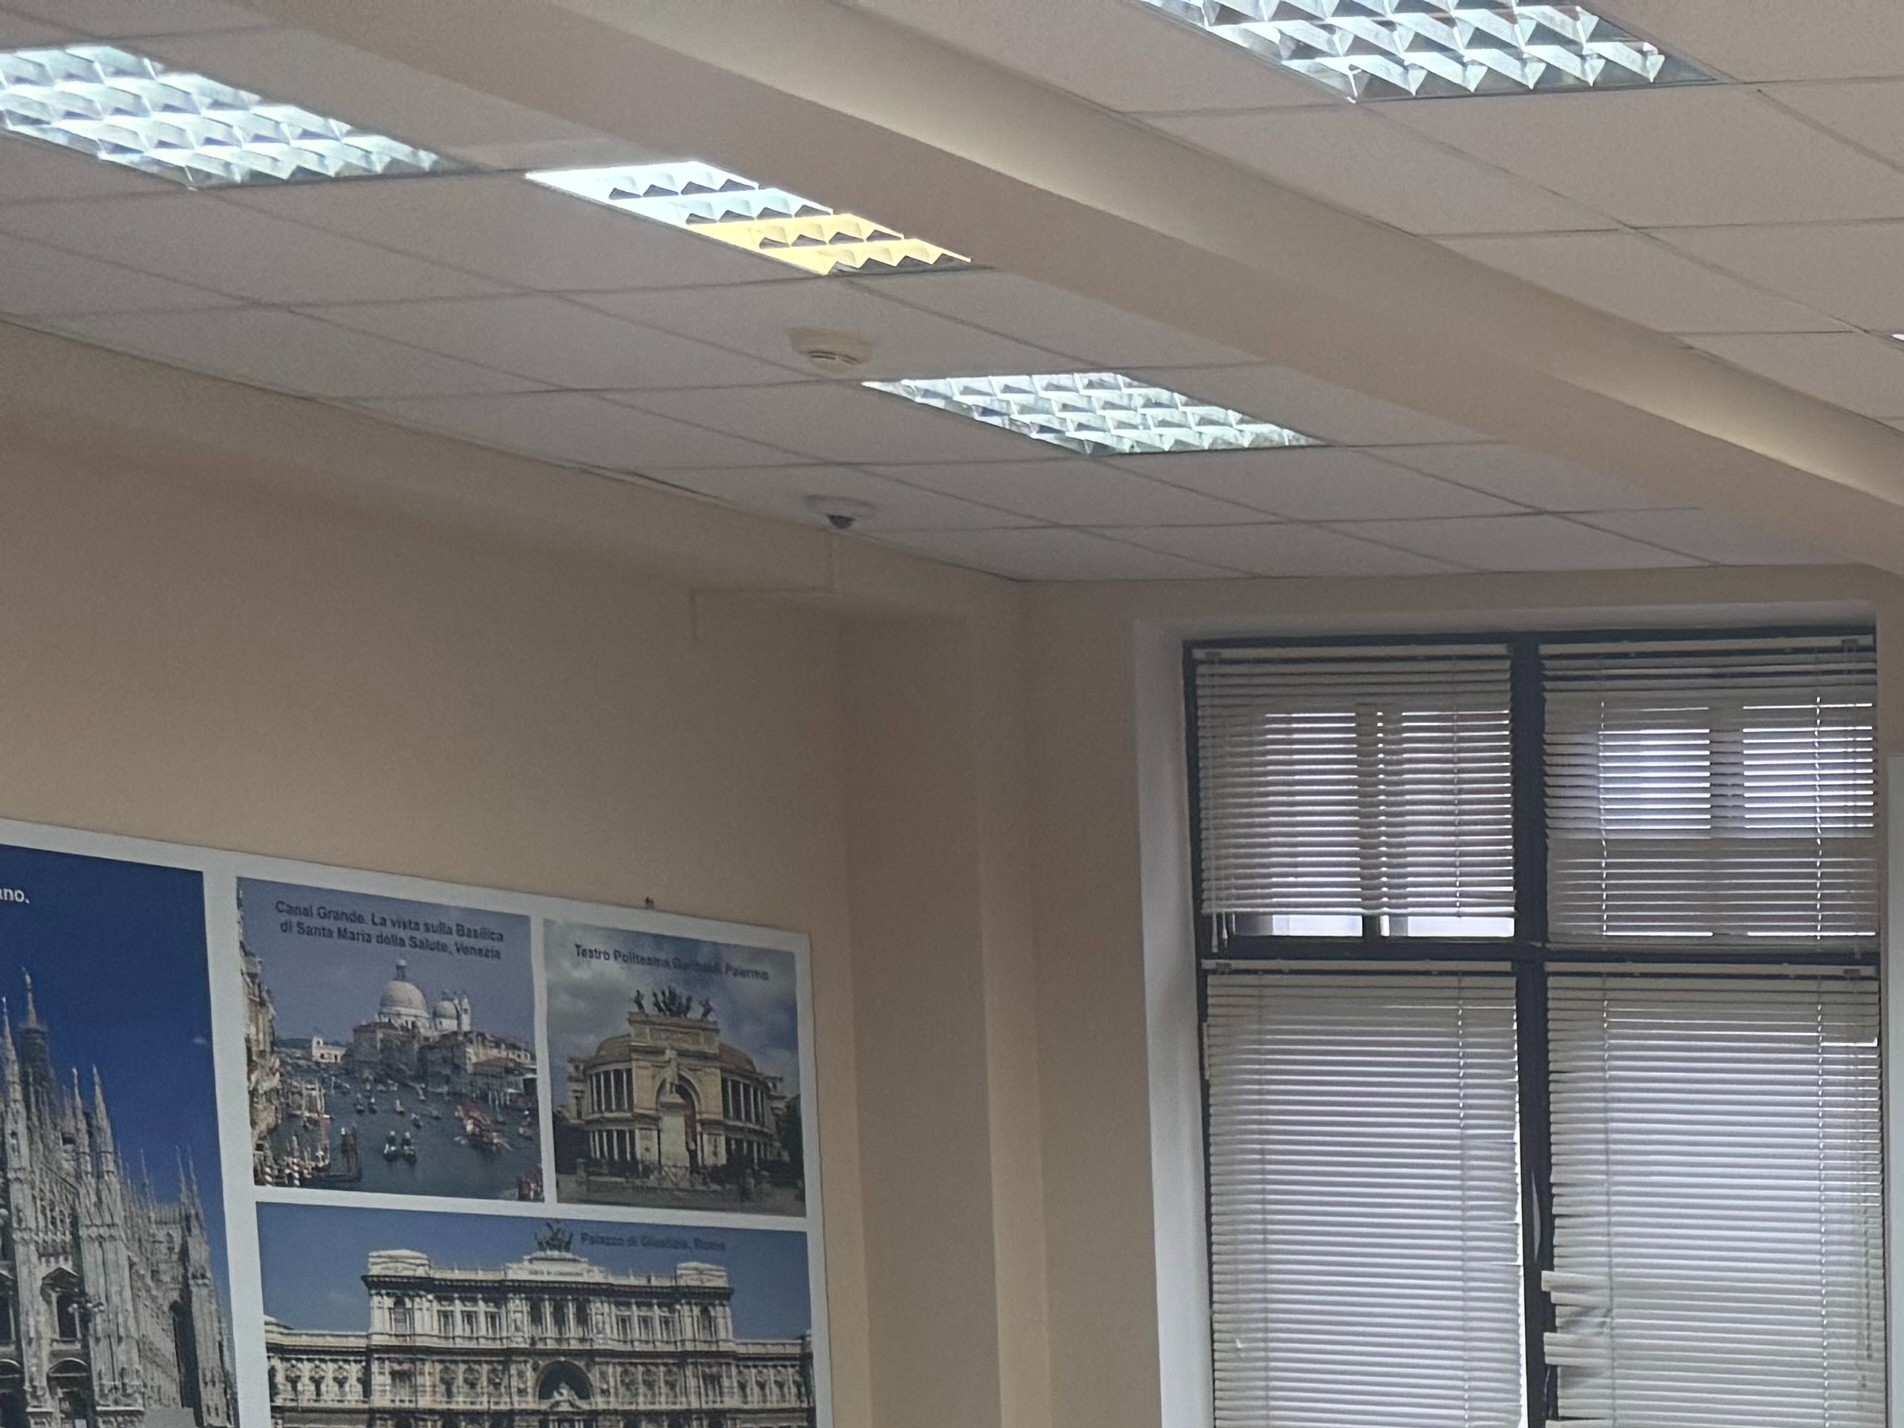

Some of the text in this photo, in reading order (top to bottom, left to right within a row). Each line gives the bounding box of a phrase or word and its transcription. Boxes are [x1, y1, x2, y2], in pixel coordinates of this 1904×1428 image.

[275, 900, 314, 917] Canal
[317, 905, 367, 925] Grande.
[371, 912, 387, 926] La
[423, 919, 453, 936] sulla
[455, 923, 504, 943] Basilica
[280, 921, 501, 960] di Santa Maria della Salute, Venezia
[574, 943, 610, 961] Teatro
